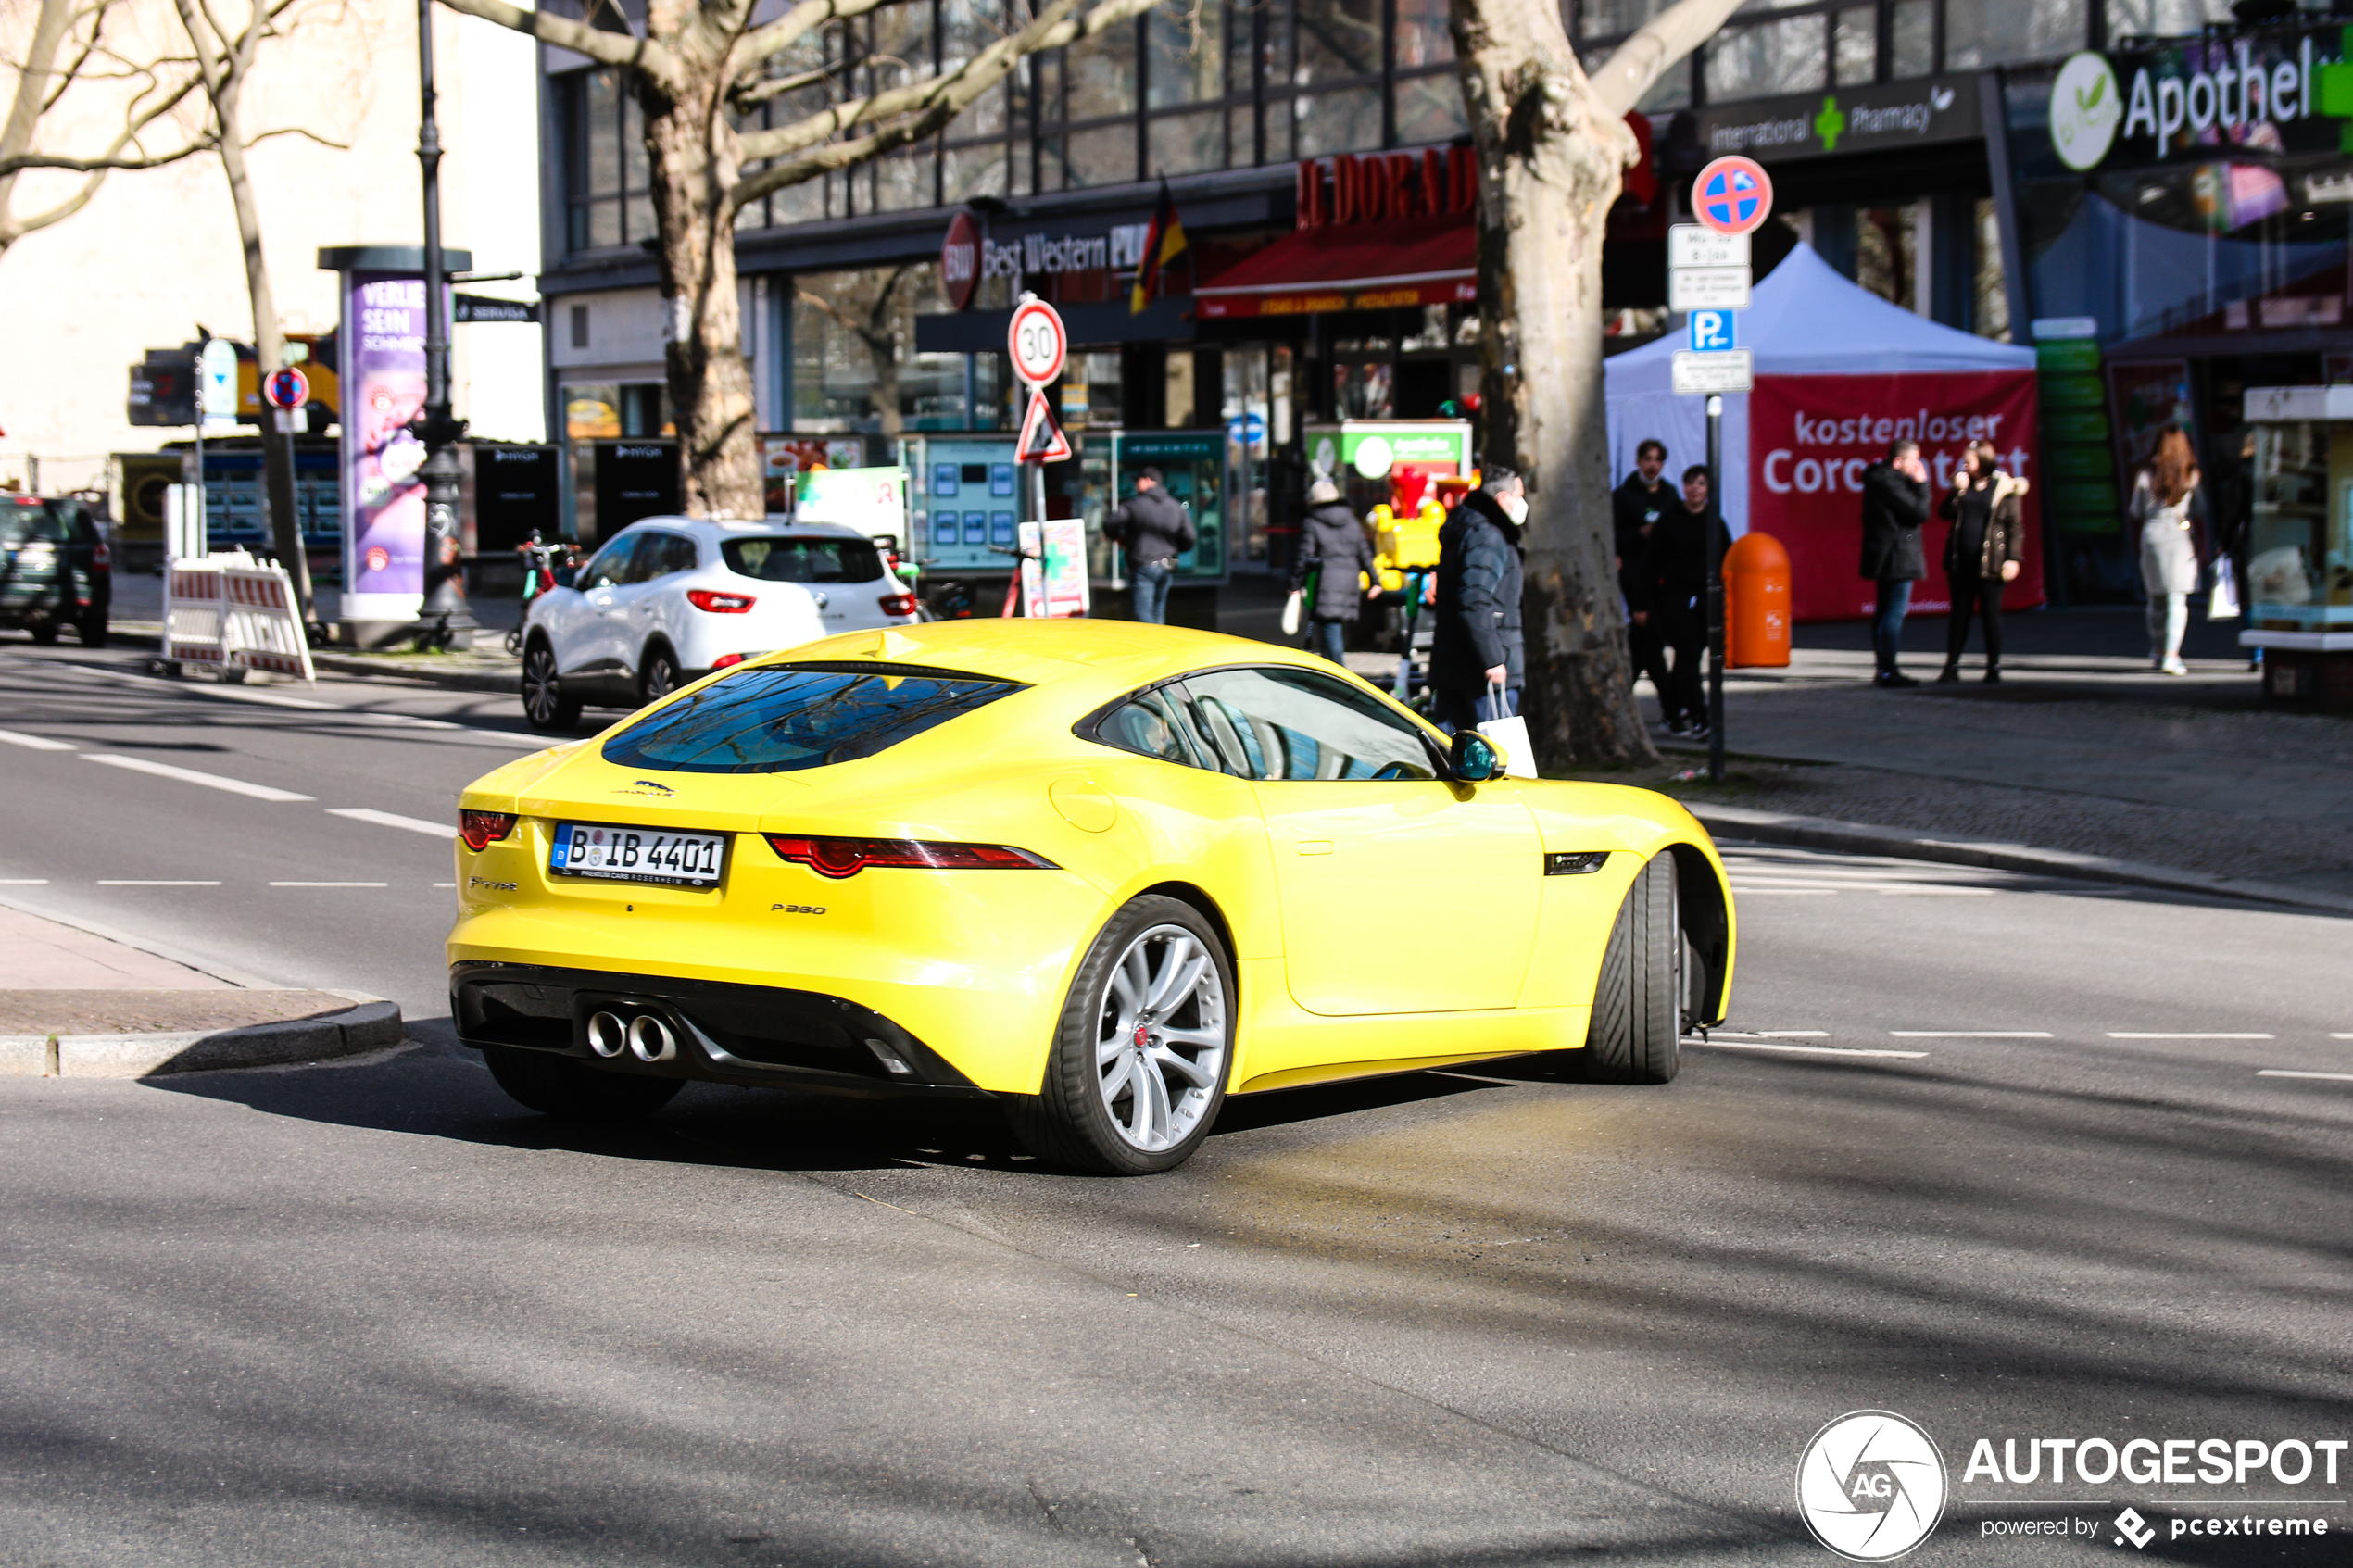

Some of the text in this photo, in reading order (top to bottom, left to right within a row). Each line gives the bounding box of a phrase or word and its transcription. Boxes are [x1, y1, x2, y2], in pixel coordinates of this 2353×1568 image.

[1851, 102, 1931, 134] Pharmacy
[1333, 146, 1478, 222] DORAD
[983, 237, 1022, 278] Best
[1024, 232, 1106, 273] Western
[362, 281, 426, 308] VERLIE
[362, 308, 409, 334] SEIN
[1694, 311, 1722, 349] P
[362, 335, 426, 351] SCHMEC
[1022, 326, 1052, 360] 30
[1795, 408, 2003, 445] kostenloser
[557, 850, 565, 860] D
[570, 830, 716, 874] B IB 4401
[469, 876, 518, 891] F-TYPE
[581, 870, 683, 884] PREMIUM CARS ROSENHEIM
